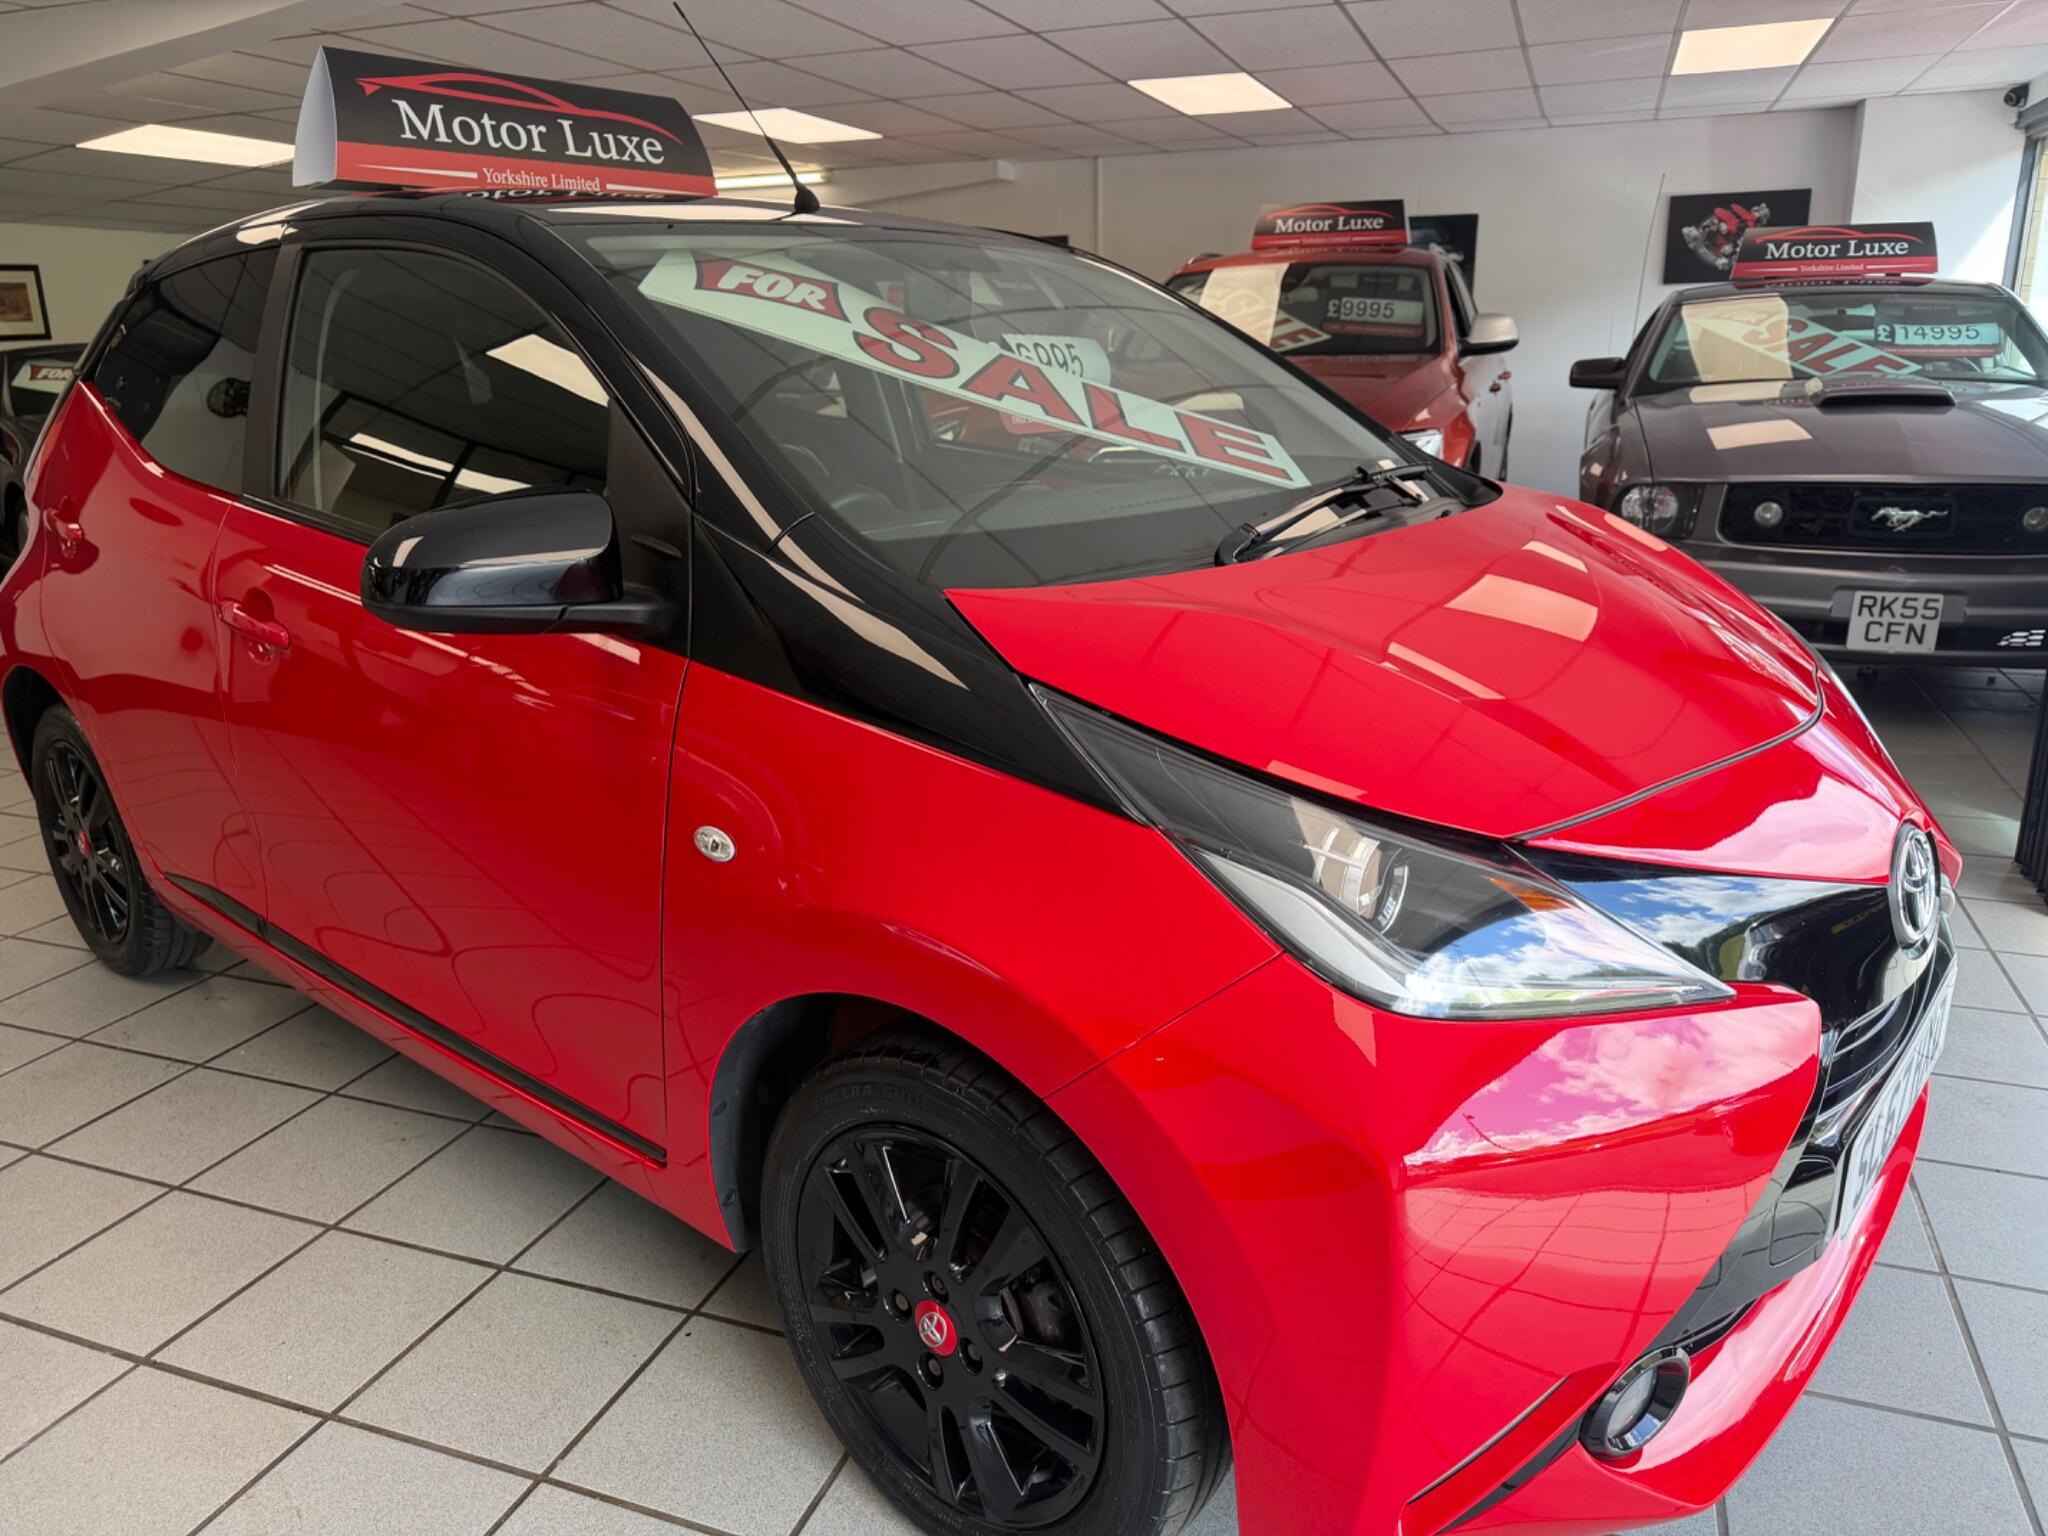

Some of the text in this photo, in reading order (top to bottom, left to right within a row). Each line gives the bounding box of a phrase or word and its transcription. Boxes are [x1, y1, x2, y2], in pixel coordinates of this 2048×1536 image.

[392, 99, 665, 165] Motor Luxe
[482, 167, 601, 192] Yorkshire Limited
[1274, 216, 1384, 233] Motor Luxe
[1765, 239, 1909, 261] Motor Luxe
[717, 264, 1295, 481] FOR SALE
[1857, 595, 1941, 620] RK55
[1864, 620, 1926, 646] CFN
